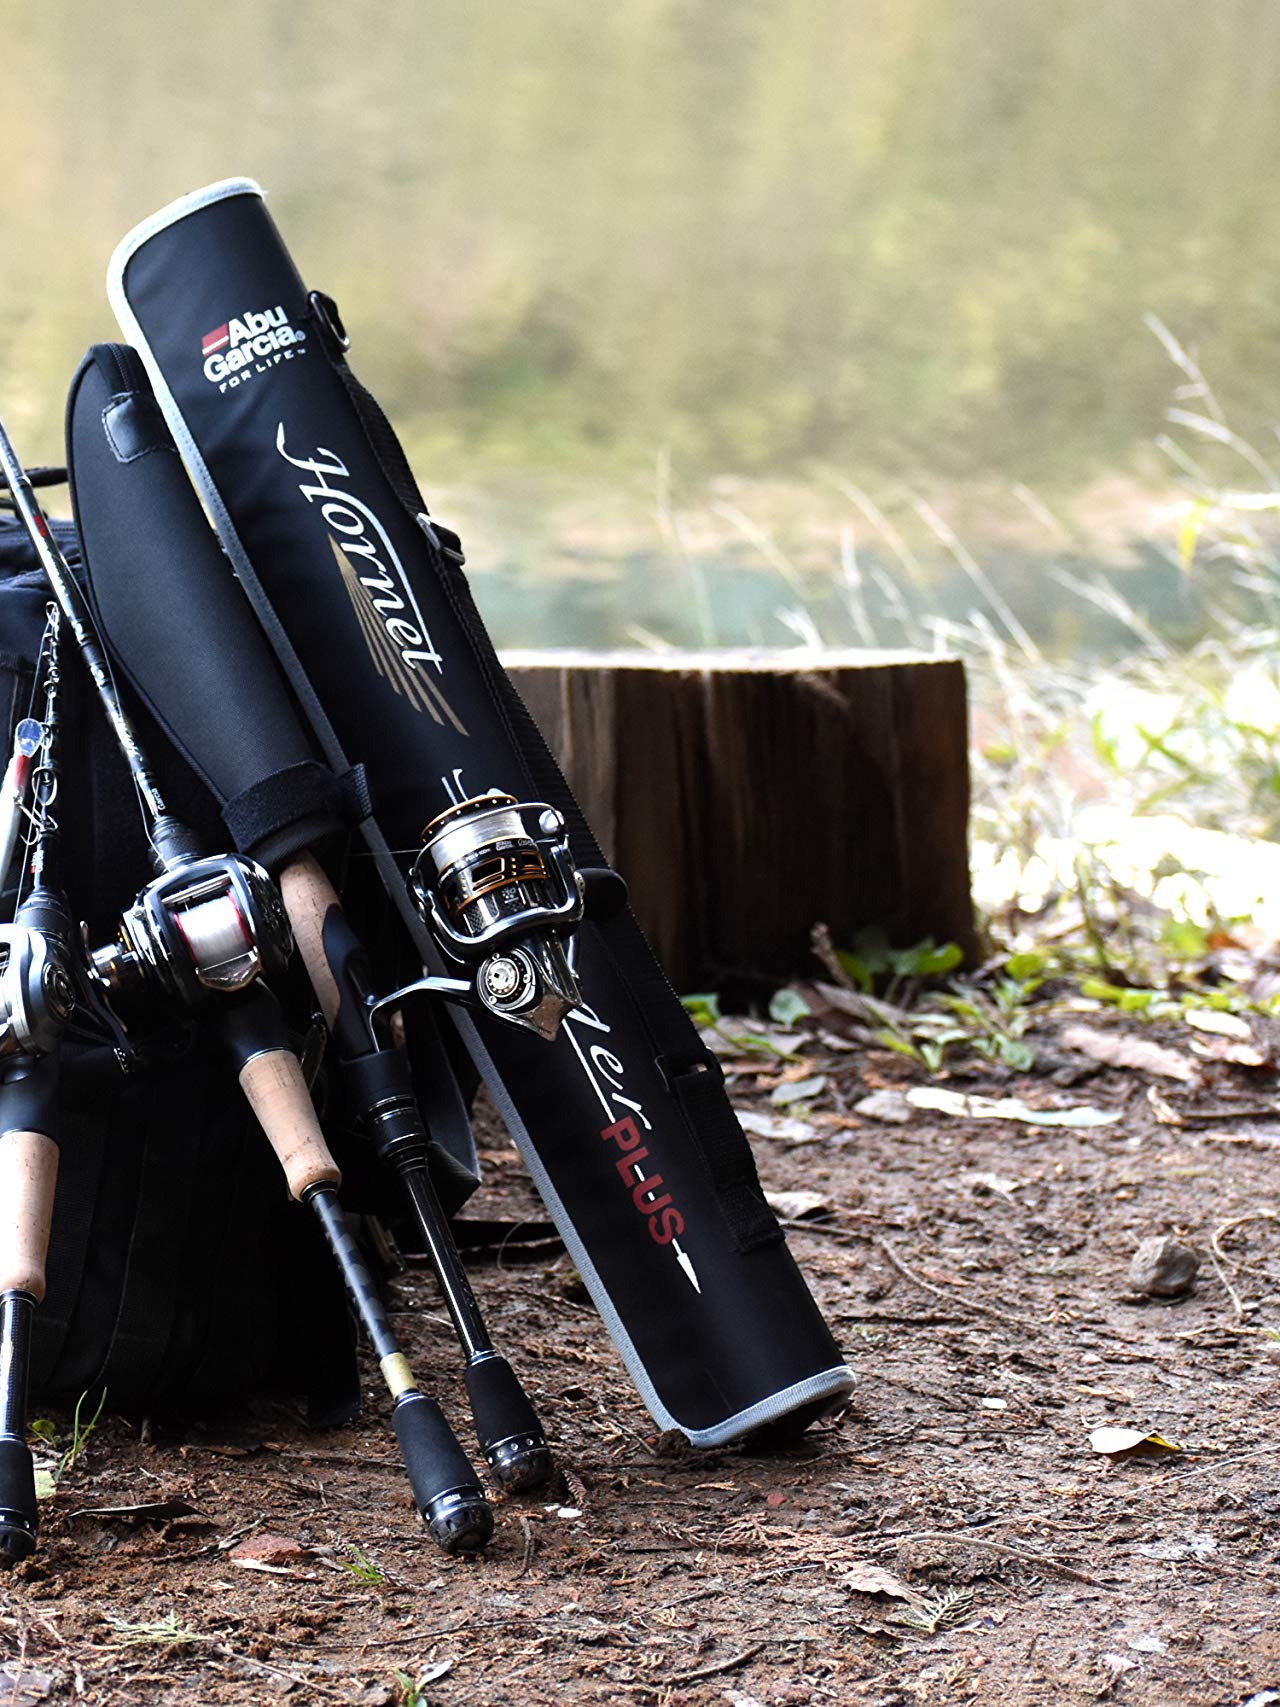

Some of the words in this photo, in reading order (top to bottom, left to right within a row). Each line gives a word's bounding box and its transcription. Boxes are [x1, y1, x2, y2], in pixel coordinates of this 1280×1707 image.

[203, 324, 297, 383] Garcia
[228, 305, 288, 348] Abu
[218, 368, 252, 394] FOR
[276, 421, 443, 675] Hornet
[600, 1115, 685, 1247] PLUS
